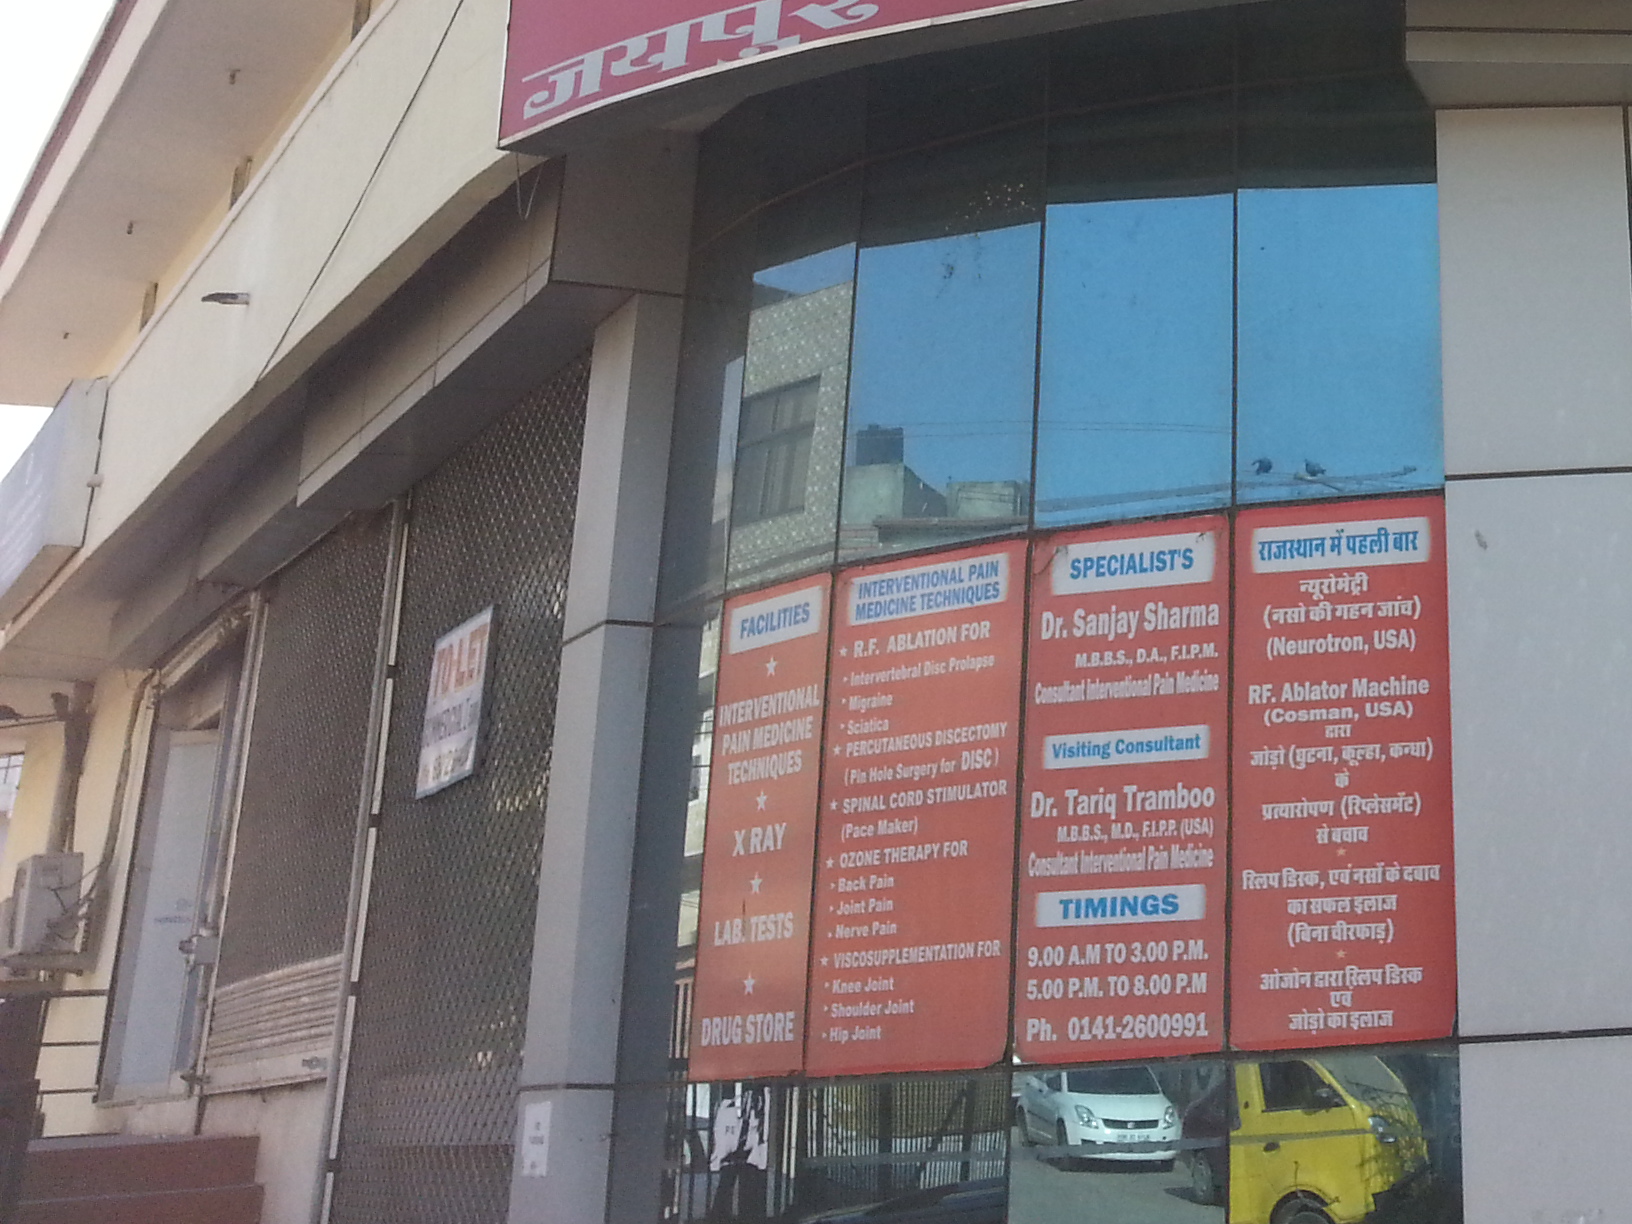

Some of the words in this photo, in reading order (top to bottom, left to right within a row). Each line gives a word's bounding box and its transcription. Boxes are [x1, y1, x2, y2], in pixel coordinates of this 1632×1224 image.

[1258, 537, 1326, 561] राजस्थान
[1330, 529, 1345, 556] में
[1347, 528, 1390, 555] पहली
[1070, 548, 1194, 580] SPECIALIST'S
[858, 566, 964, 600] INTERVENTIONAL
[968, 560, 999, 582] PAIN
[855, 594, 916, 621] MEDICINE
[920, 582, 1000, 610] TECHNIQUES
[1309, 602, 1333, 622] की
[1335, 602, 1374, 620] गहन
[740, 602, 810, 639] FACILITIES
[1041, 611, 1067, 640] Dr.
[1073, 605, 1139, 641] Sanjay
[1144, 601, 1220, 632] Sharma
[854, 638, 880, 658] R.F.
[886, 626, 957, 654] ABLATION
[960, 620, 991, 642] FOR
[1266, 634, 1369, 660] (Neurotron,
[1374, 628, 1416, 652] USA)
[1075, 650, 1132, 668] M.B.B.S.,
[1136, 648, 1167, 664] D.A.,
[1171, 642, 1218, 660] F.I.P.M.
[850, 663, 921, 686] Intervertebral
[924, 659, 946, 676] Disc
[950, 654, 996, 672] Prolapse
[1035, 679, 1085, 704] Consultant
[1153, 672, 1174, 695] Pain
[1176, 669, 1219, 694] Medicine
[1248, 684, 1276, 704] RF.
[1281, 680, 1348, 702] Ablator
[1352, 674, 1430, 698] Machine
[719, 684, 820, 726] INTERVENTIONAL
[848, 692, 892, 712] Migraine
[1264, 706, 1359, 726] (Cosman,
[1366, 700, 1413, 718] USA)
[722, 730, 751, 755] PAIN
[753, 716, 813, 750] MEDICINE
[846, 731, 932, 757] PERCUTANEOUS
[935, 722, 1008, 744] DISCECTOMY
[847, 716, 889, 734] Sciatica
[1052, 741, 1111, 760] Visiting
[1115, 734, 1201, 754] Consultant
[728, 750, 802, 785] TECHNIQUES
[869, 765, 893, 782] Hole
[896, 762, 938, 780] Surgery
[940, 758, 956, 772] for
[1334, 768, 1350, 788] के
[843, 794, 886, 814] SPINAL
[890, 790, 924, 808] CORD
[926, 779, 1008, 804] STIMULATOR
[1030, 791, 1057, 818] Dr.
[1065, 787, 1116, 820] Tariq
[1123, 782, 1215, 812] Tramboo
[732, 830, 744, 857] X
[750, 822, 786, 854] RAY
[841, 823, 874, 842] (Pace
[877, 816, 918, 836] Maker)
[1180, 817, 1214, 839] (USA)
[1316, 824, 1330, 844] से
[840, 849, 880, 868] OZONE
[884, 842, 940, 864] THERAPY
[942, 839, 968, 858] FOR
[1028, 851, 1078, 877] Consultant
[1080, 846, 1146, 874] Interventional
[1148, 845, 1168, 870] Pain
[1170, 843, 1214, 869] Medicine
[838, 876, 866, 892] Back
[869, 874, 894, 889] Pain
[836, 900, 866, 916] Joint
[868, 898, 894, 912] Pain
[1059, 893, 1180, 920] TIMINGS
[1287, 899, 1308, 915] का
[1311, 897, 1350, 914] सफल
[1354, 894, 1398, 914] इलाज
[714, 919, 745, 946] LAB.
[750, 912, 794, 941] TESTS
[836, 924, 869, 938] Nerve
[872, 921, 896, 935] Pain
[834, 942, 974, 969] VISCOSUPPLEMENTATION
[977, 940, 1002, 957] FOR
[1028, 945, 1064, 968] 9.00
[1068, 944, 1100, 966] A.M
[1105, 943, 1127, 964] TO
[1130, 941, 1168, 963] 3.00
[1172, 940, 1209, 961] P.M.
[832, 979, 862, 994] Knee
[864, 977, 894, 992] Joint
[1026, 978, 1064, 1000] 5.00
[1068, 977, 1104, 998] P.M.
[1108, 976, 1130, 996] TO
[1134, 974, 1172, 996] 8.00
[1176, 972, 1208, 994] P.M
[831, 1002, 882, 1018] Shoulder
[884, 999, 914, 1014] Joint
[1328, 1012, 1348, 1028] का
[1350, 1010, 1394, 1030] इलाज
[701, 1014, 742, 1047] DRUG
[745, 1011, 795, 1044] STORE
[829, 1027, 849, 1044] Hip
[852, 1026, 882, 1041] Joint
[1026, 1018, 1057, 1042] Ph.
[1068, 1012, 1208, 1041] 0141-2600991
